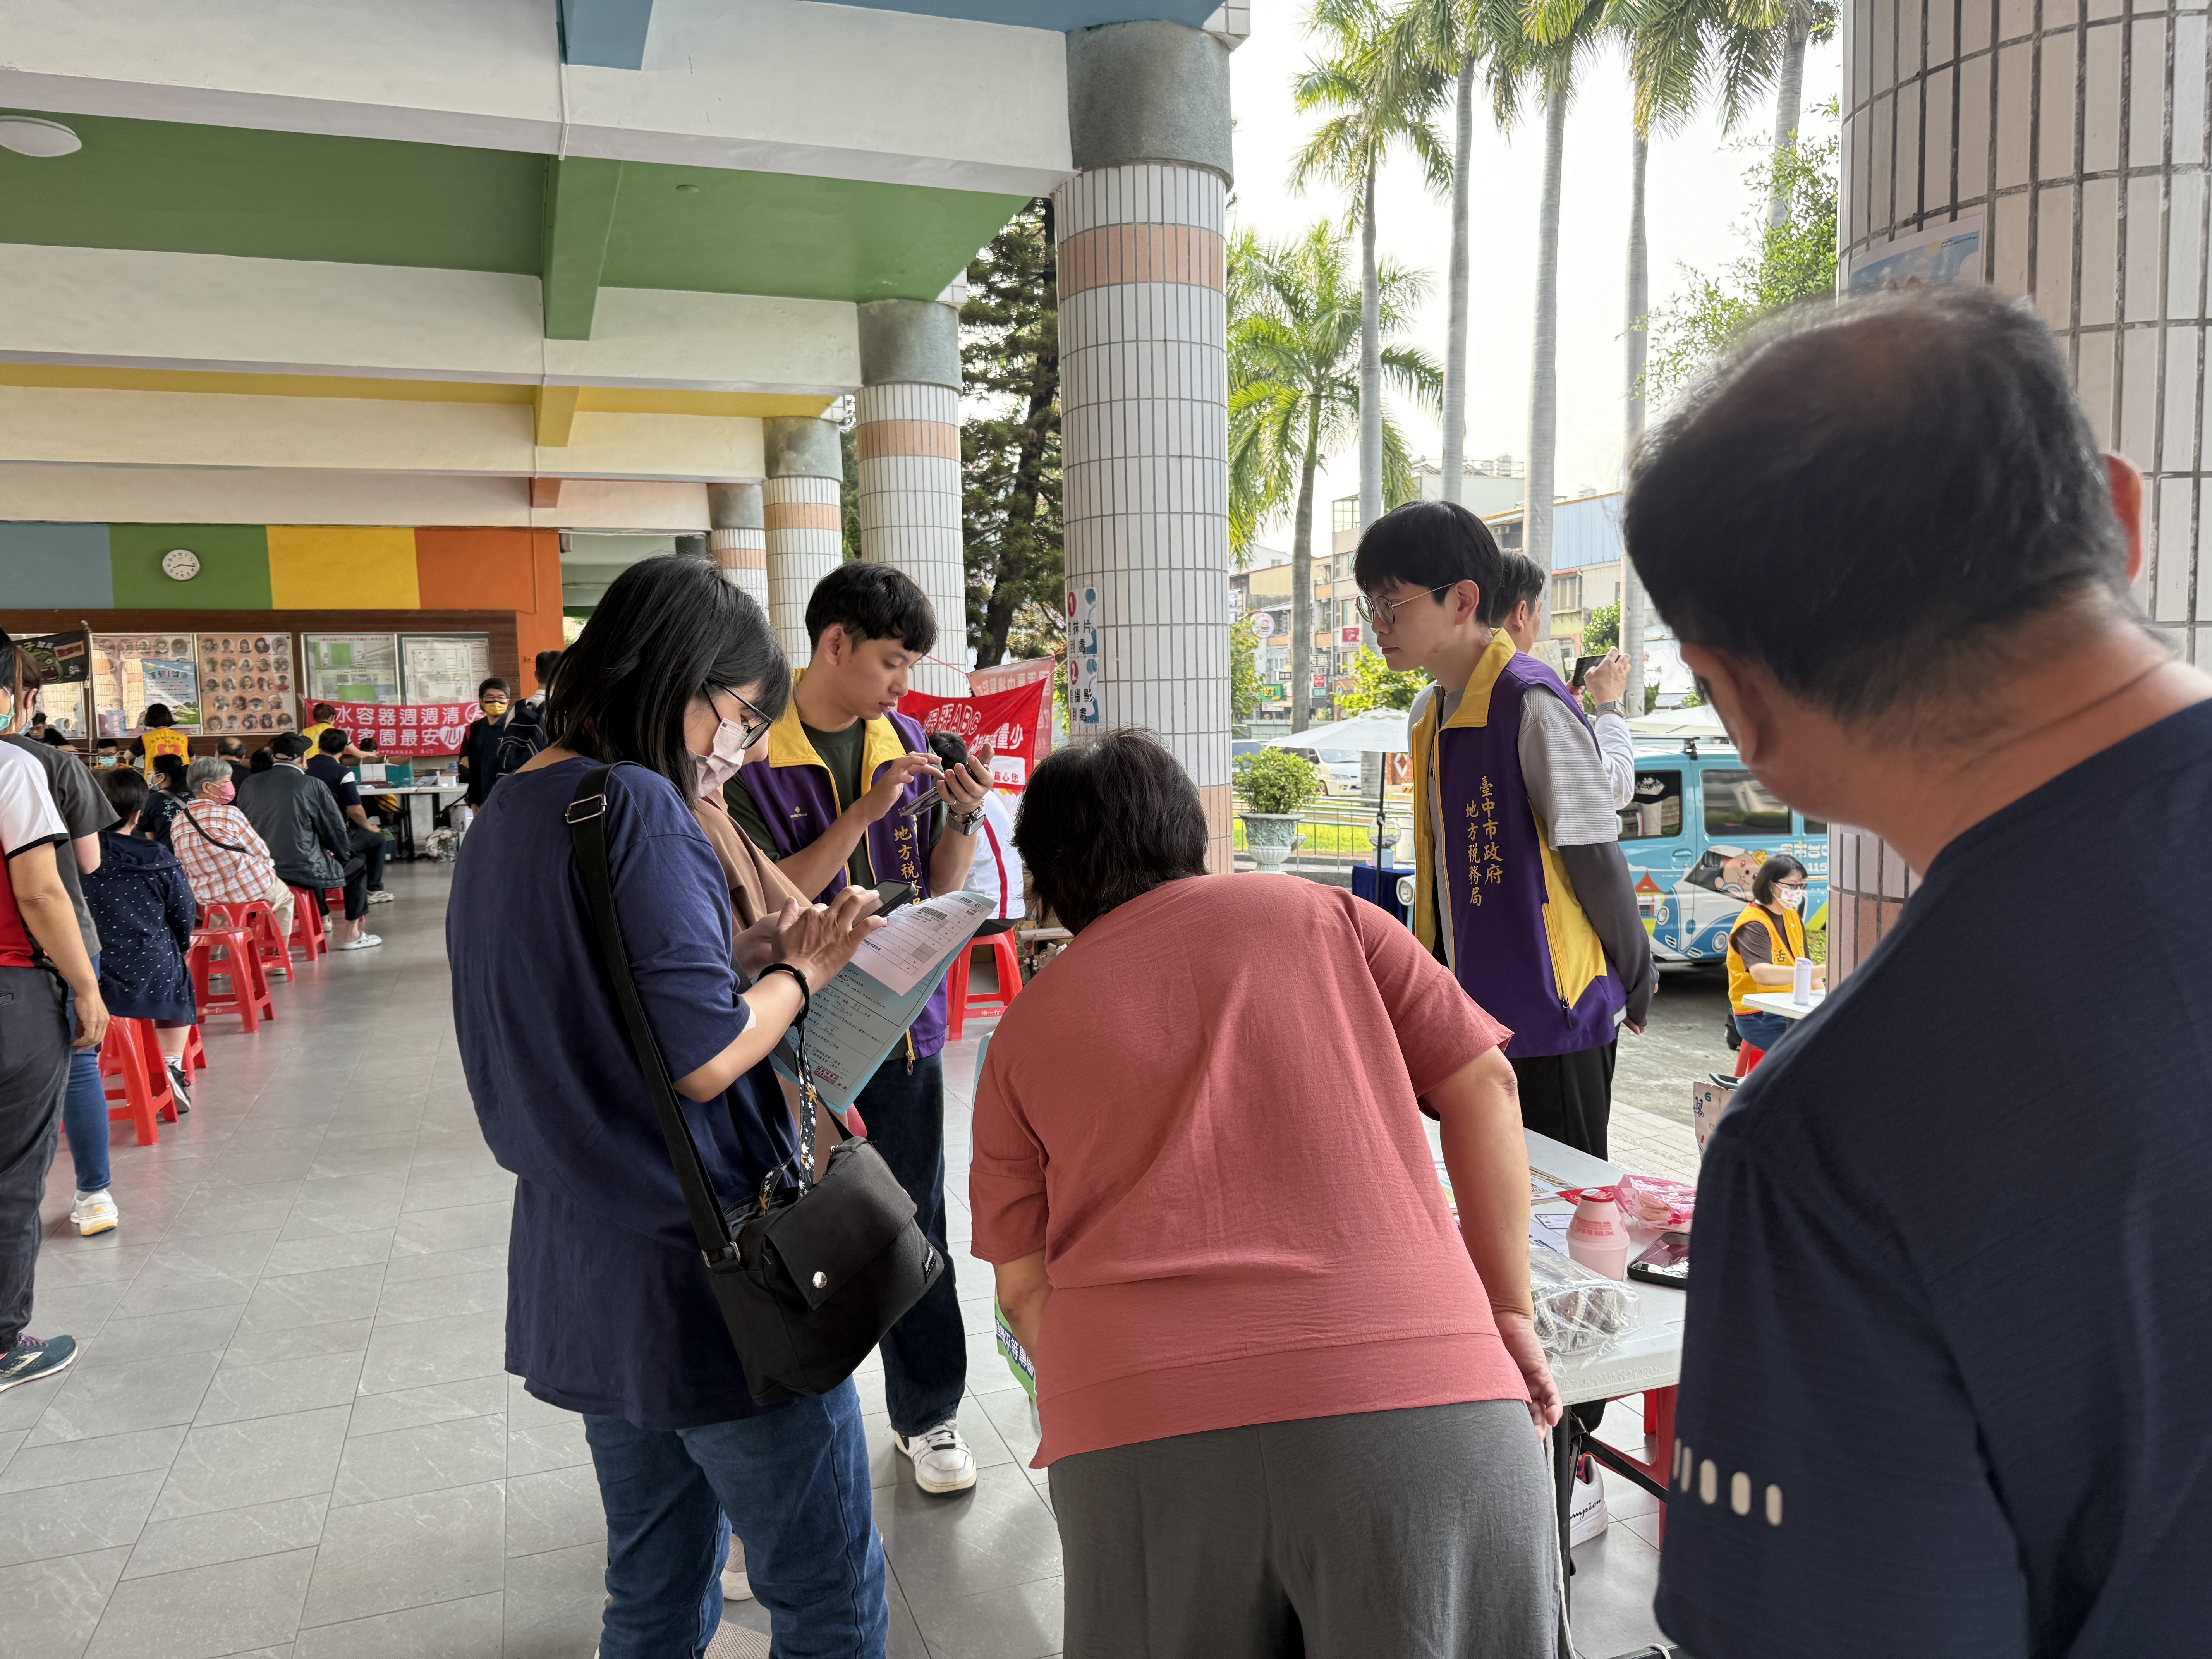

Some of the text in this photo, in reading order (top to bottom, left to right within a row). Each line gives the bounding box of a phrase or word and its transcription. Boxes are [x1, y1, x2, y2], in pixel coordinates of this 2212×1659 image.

[313, 703, 460, 726] 水容器週週清
[1480, 776, 1503, 885] 臺中市政府
[1466, 800, 1482, 907] 地方稅務局
[1773, 949, 1786, 962] 活
[1570, 1498, 1601, 1519] mpion
